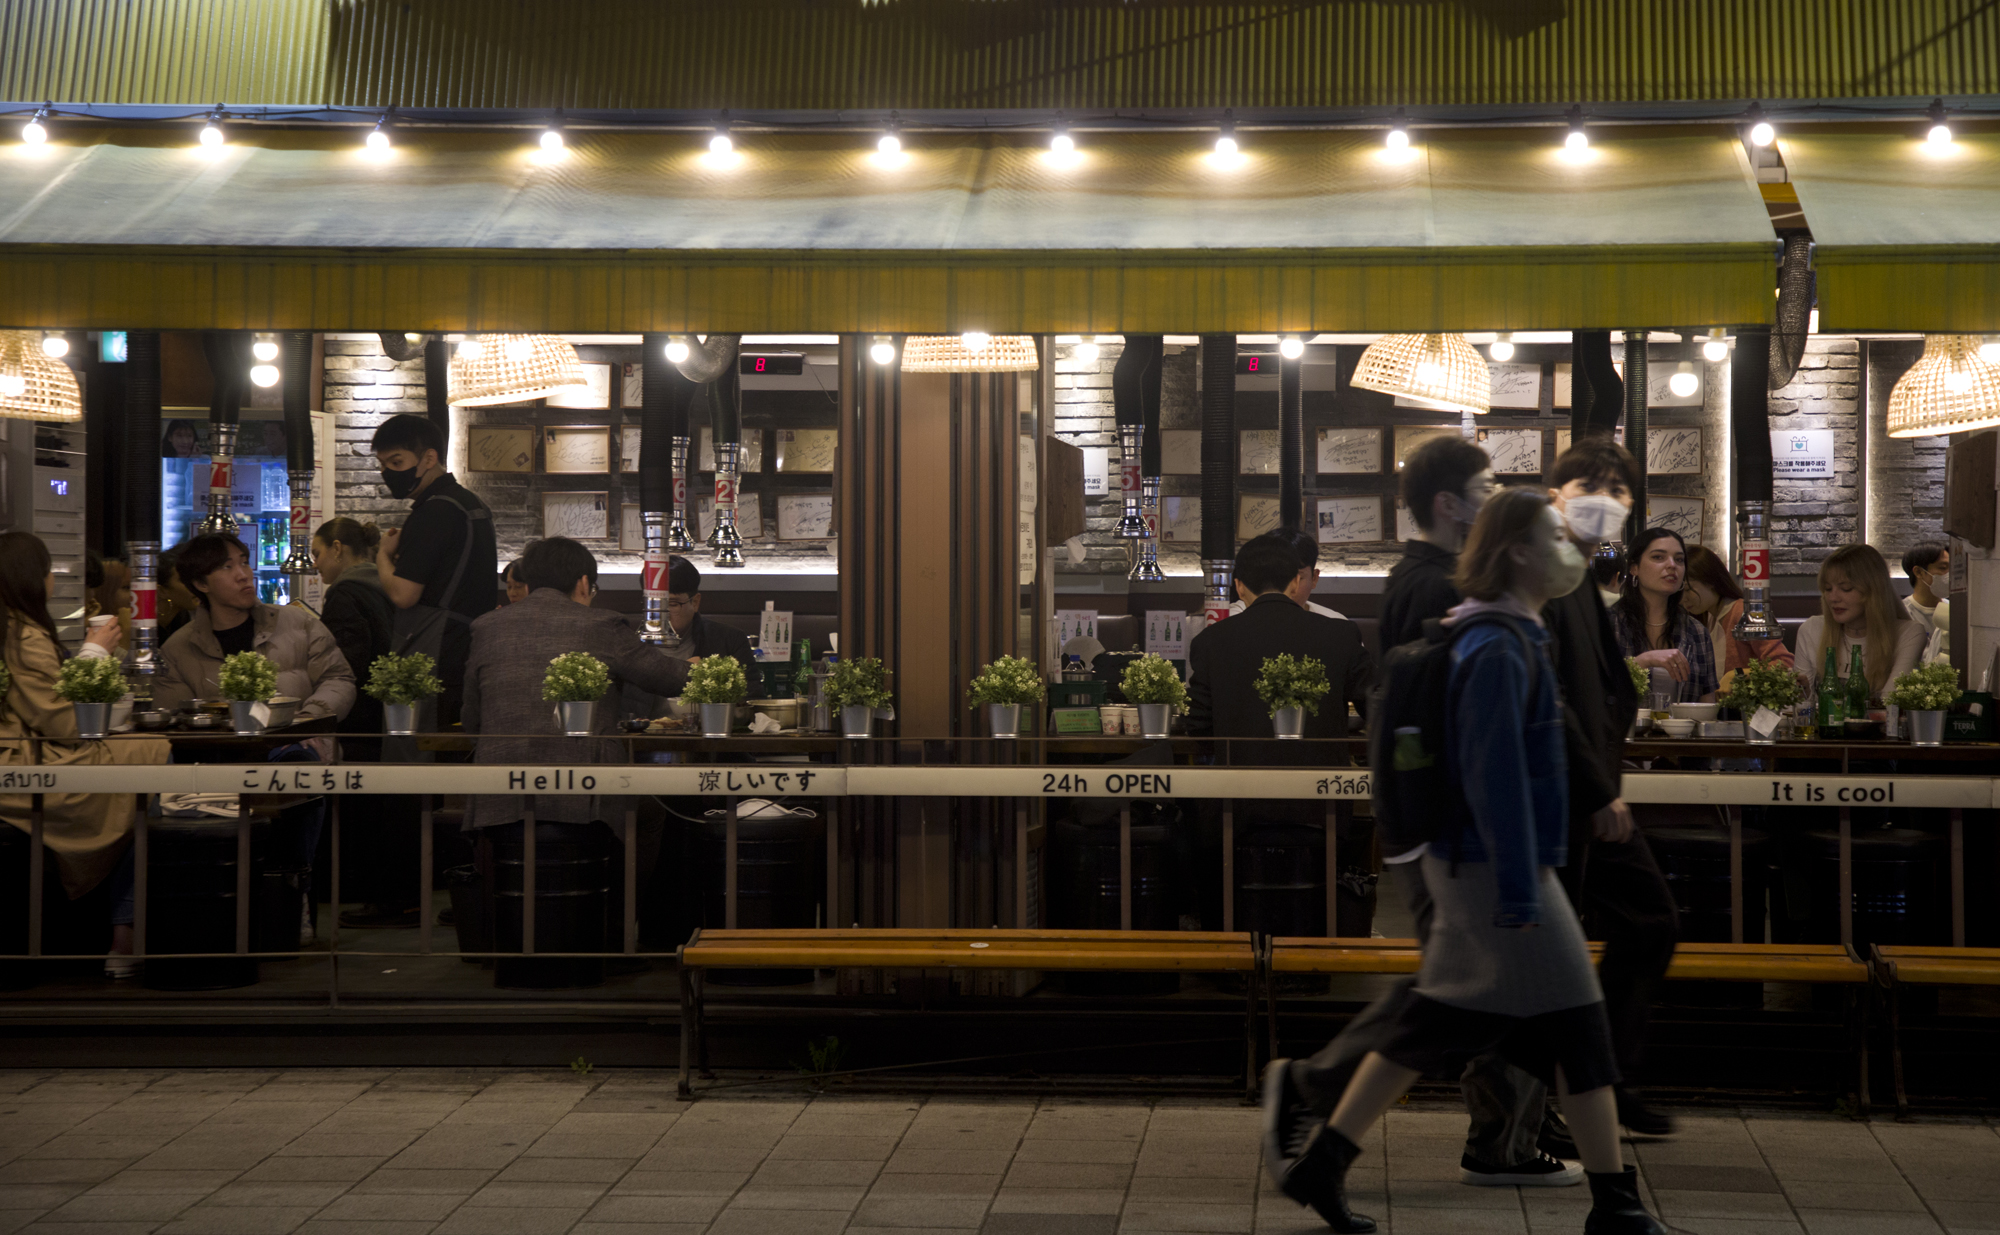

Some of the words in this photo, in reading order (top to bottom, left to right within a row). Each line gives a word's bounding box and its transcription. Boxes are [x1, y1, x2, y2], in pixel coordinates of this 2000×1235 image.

[755, 357, 766, 372] 8
[1248, 357, 1259, 371] 8
[674, 480, 686, 503] 6
[649, 563, 666, 589] 7
[1745, 551, 1762, 579] 5
[1952, 720, 1976, 730] TERRA
[0, 771, 56, 788] สบาย
[243, 769, 364, 792] こんにちは
[509, 769, 596, 791] Hello
[698, 770, 816, 793] 涼しいです
[1042, 773, 1088, 793] 24h
[1105, 773, 1171, 794] OPEN
[1771, 782, 1794, 802] It
[1806, 782, 1825, 803] is
[1837, 781, 1894, 803] cool
